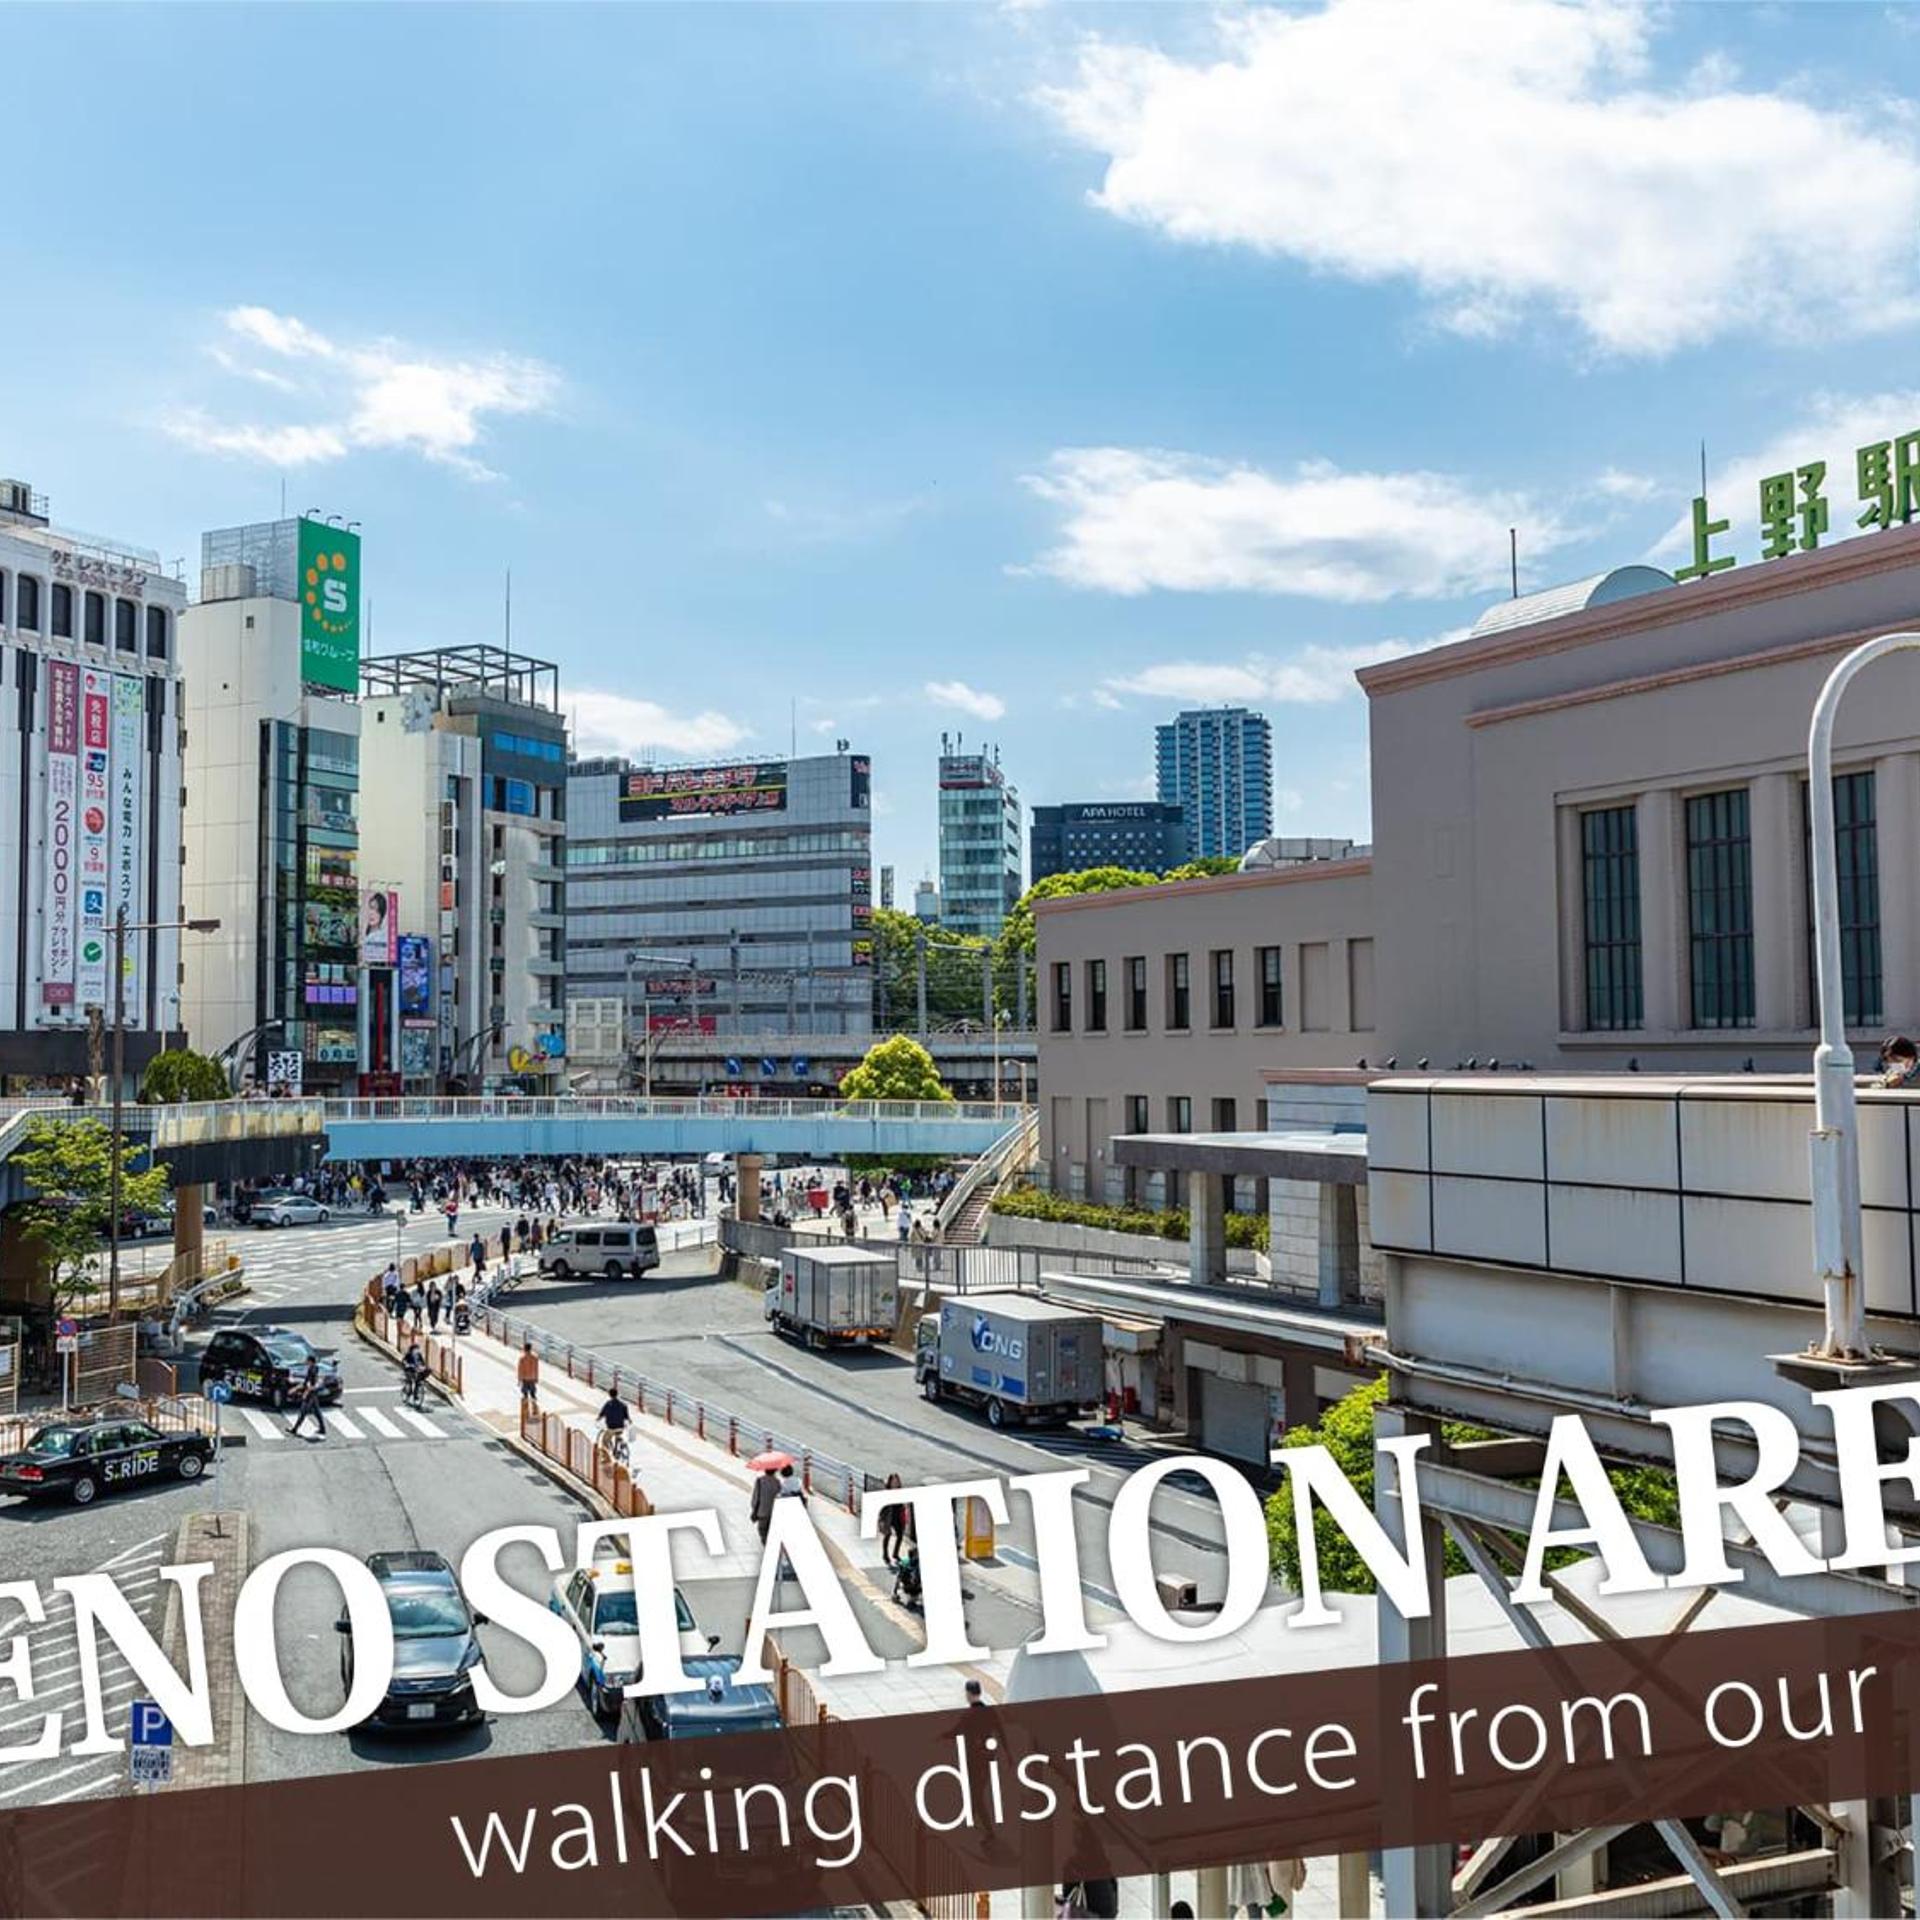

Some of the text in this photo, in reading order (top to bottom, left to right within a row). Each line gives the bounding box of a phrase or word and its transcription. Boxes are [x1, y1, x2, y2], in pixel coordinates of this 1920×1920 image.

[1675, 429, 1920, 582] 上野駅
[1082, 806, 1147, 818] APA HOTEL
[980, 1330, 1023, 1360] CNG
[143, 1706, 166, 1741] P
